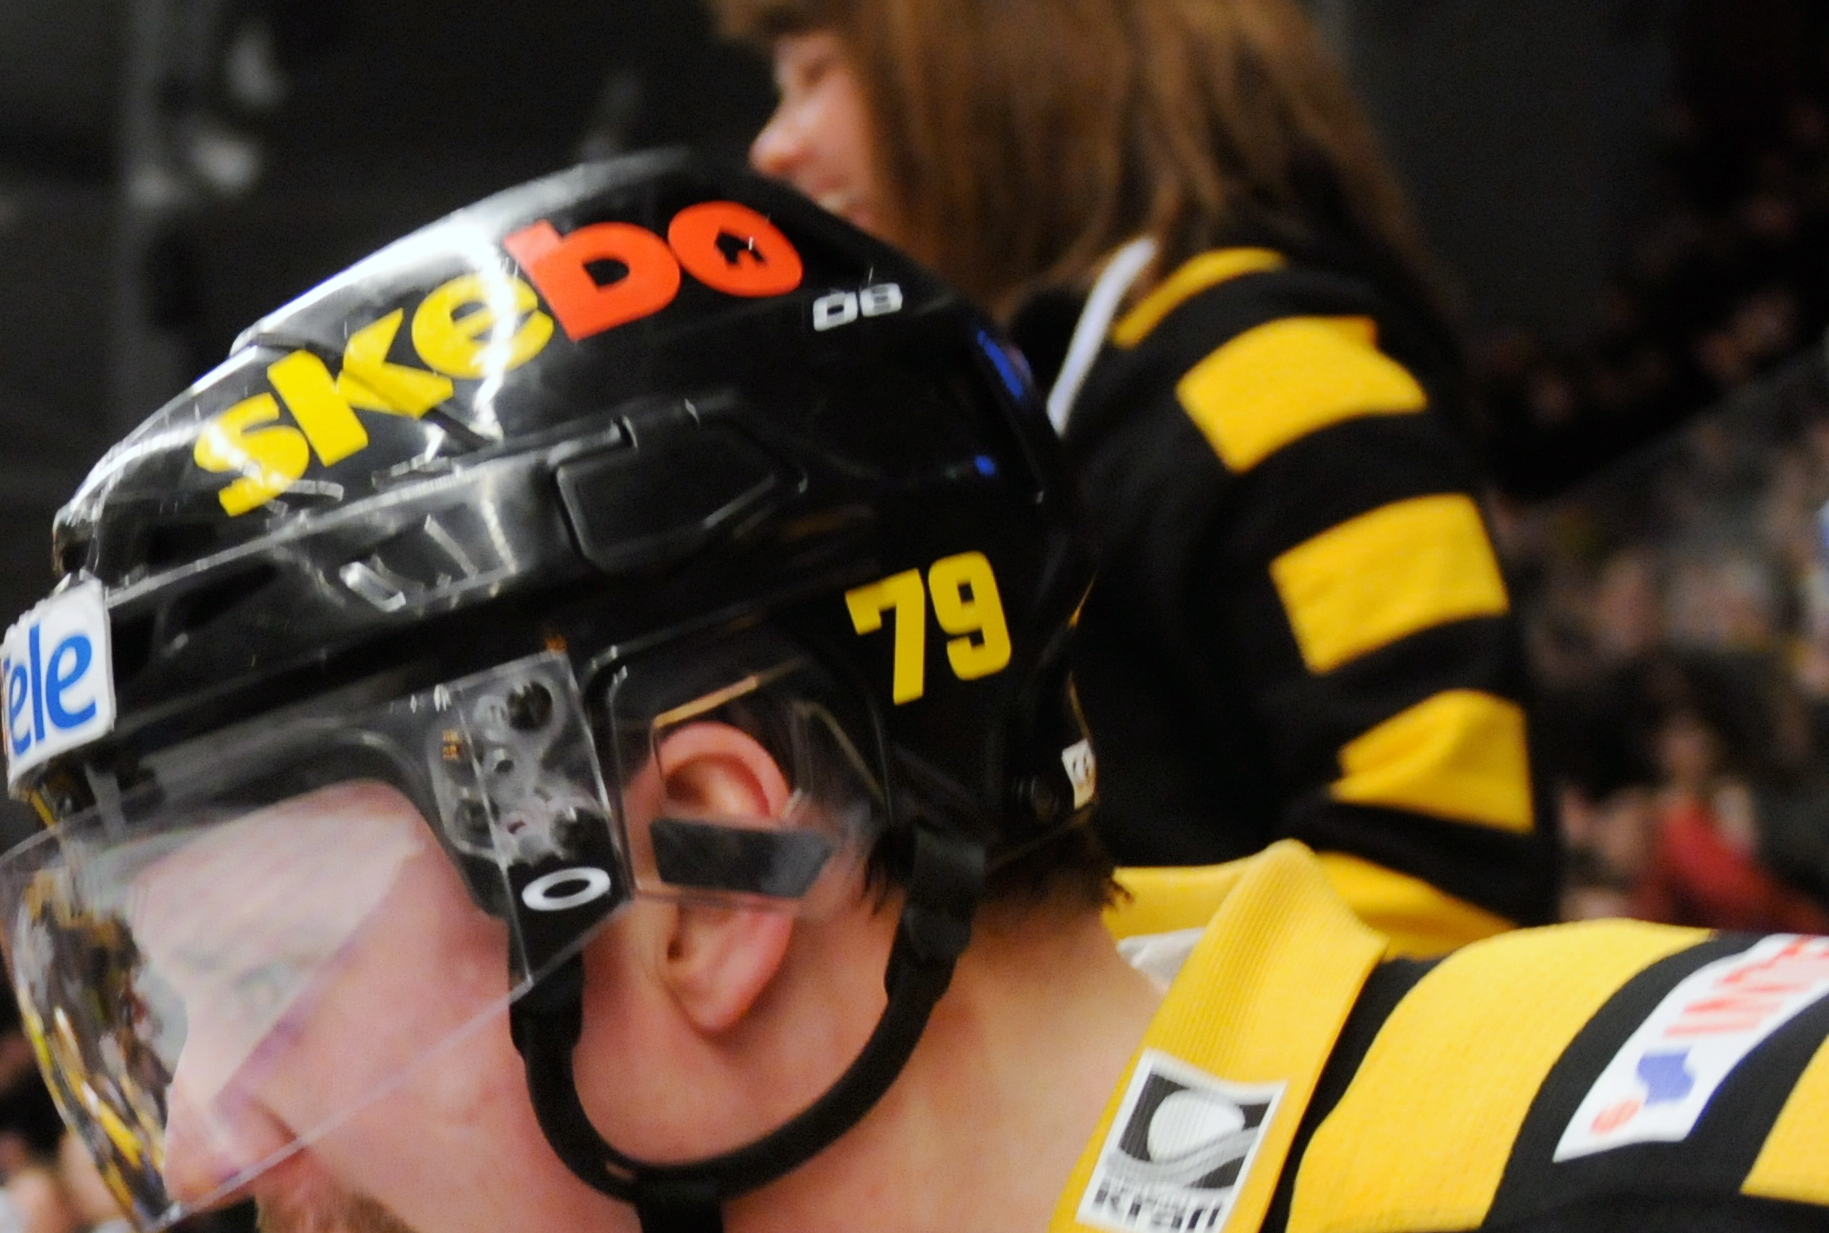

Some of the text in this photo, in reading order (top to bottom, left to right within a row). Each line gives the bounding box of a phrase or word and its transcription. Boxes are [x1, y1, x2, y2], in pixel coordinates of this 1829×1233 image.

[194, 200, 802, 517] skebo
[2, 622, 98, 756] ele
[845, 550, 1012, 705] 79
